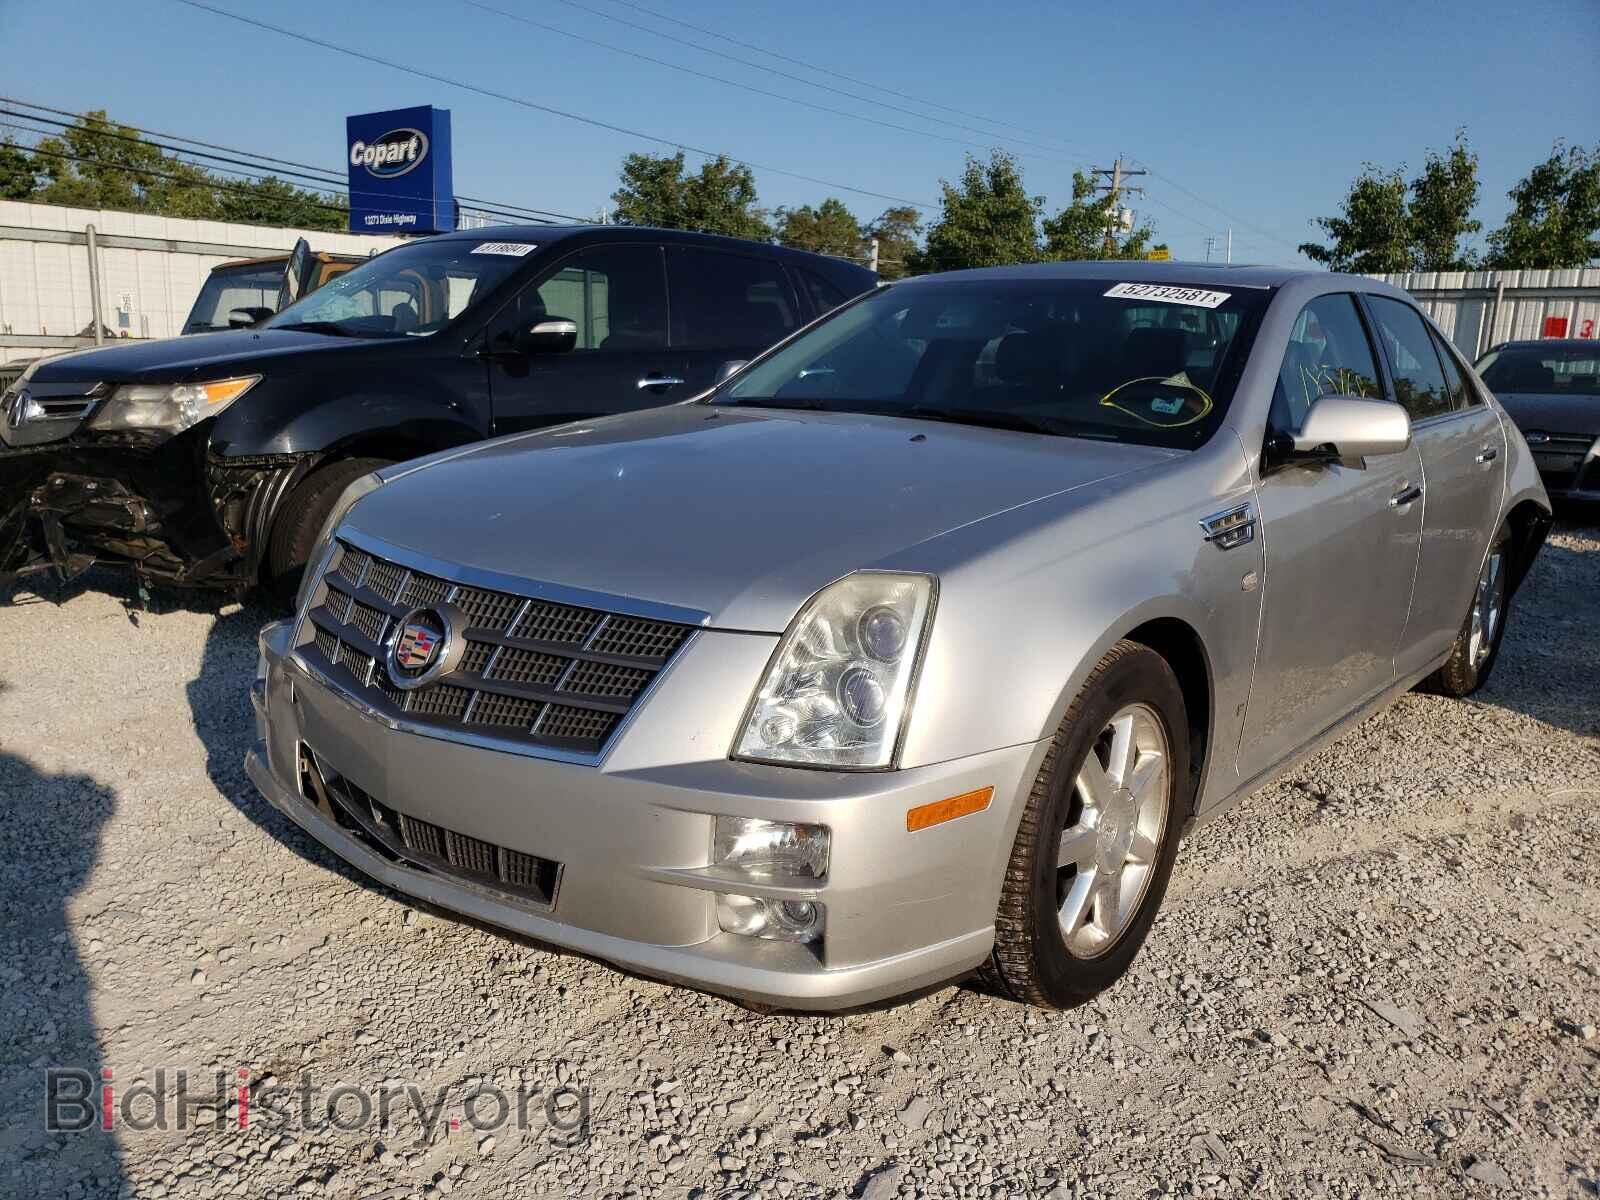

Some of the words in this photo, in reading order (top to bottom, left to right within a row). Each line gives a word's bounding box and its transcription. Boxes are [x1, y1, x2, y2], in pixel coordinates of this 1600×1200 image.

[350, 134, 418, 170] Copart
[364, 215, 380, 225] 13273
[380, 214, 393, 224] Dixie
[393, 213, 417, 226] Highway
